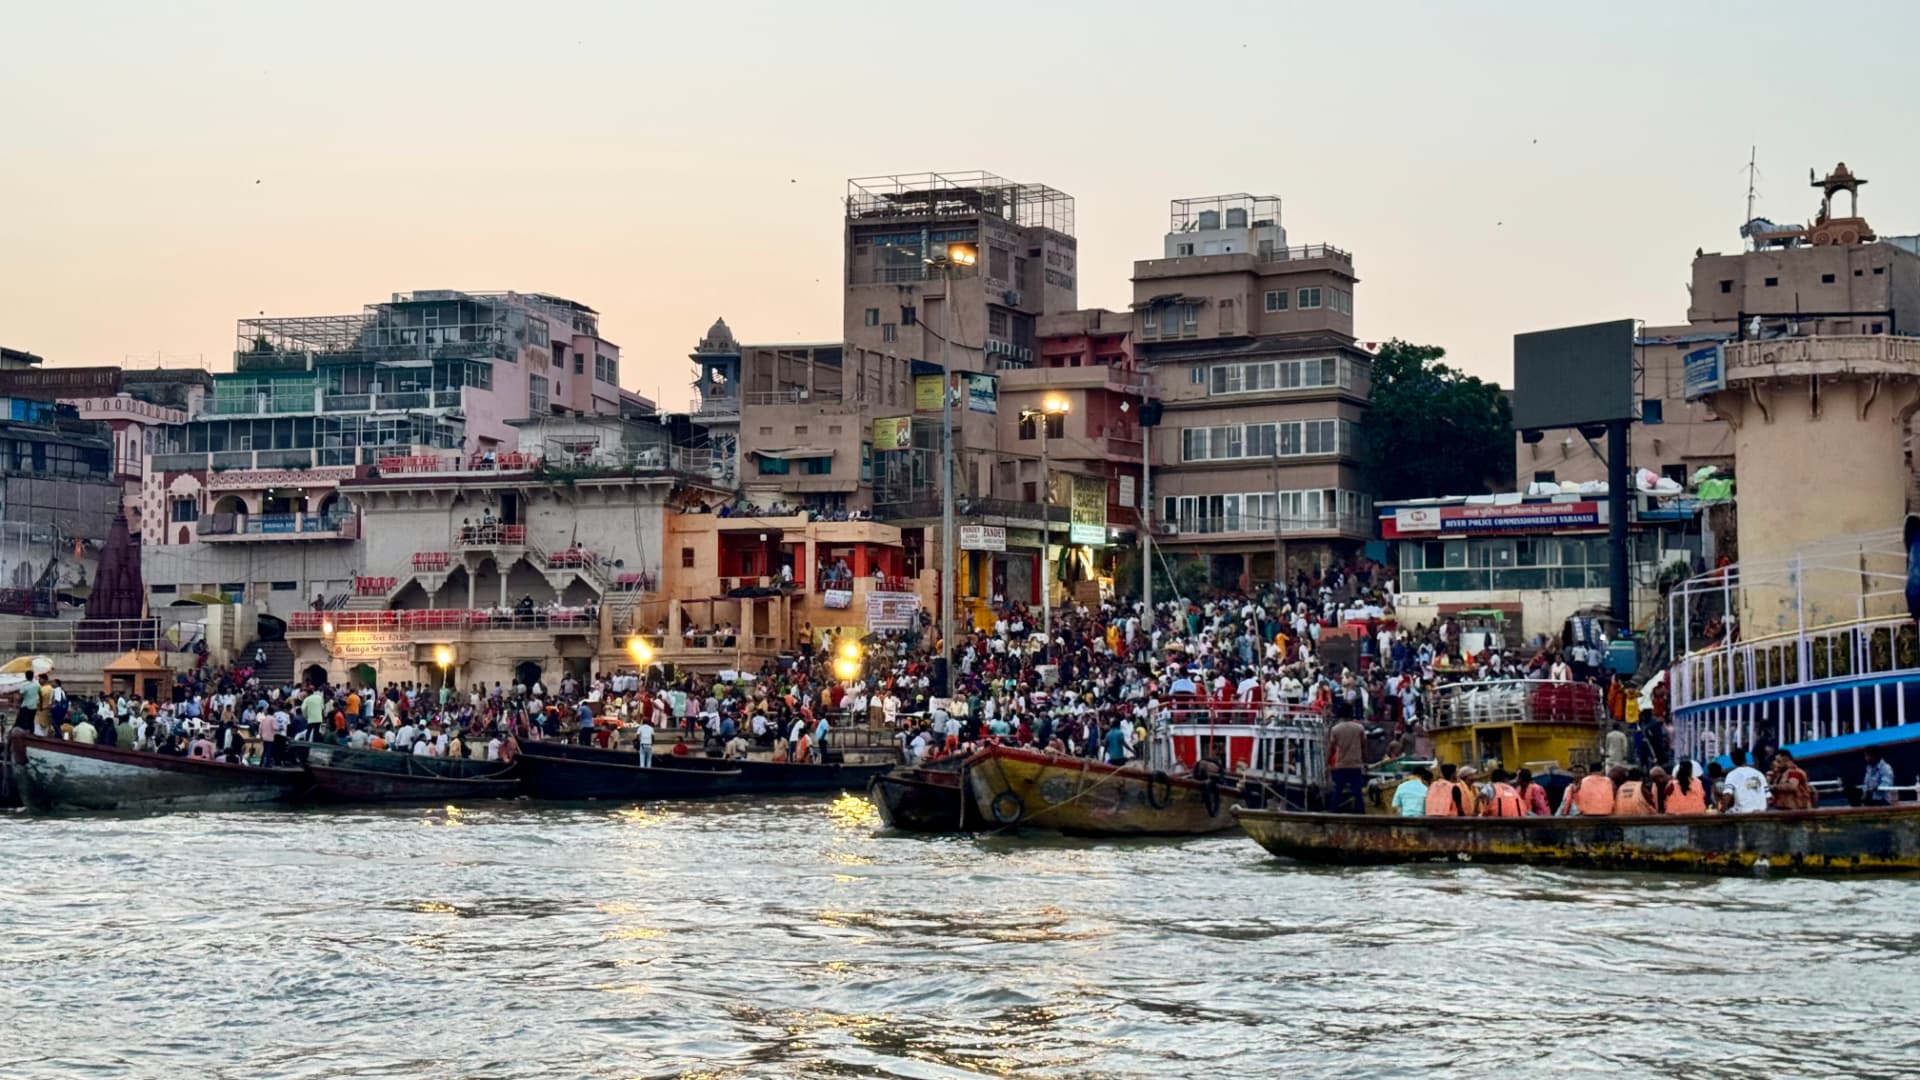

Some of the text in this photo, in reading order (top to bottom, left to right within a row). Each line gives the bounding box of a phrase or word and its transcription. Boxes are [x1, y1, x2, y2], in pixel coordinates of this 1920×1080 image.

[1445, 519, 1466, 528] RIVER
[1468, 518, 1493, 527] POLICE
[1494, 516, 1558, 526] COMMISSIONERATE
[1559, 514, 1594, 524] VARANASI
[984, 527, 1005, 538] PANDEY
